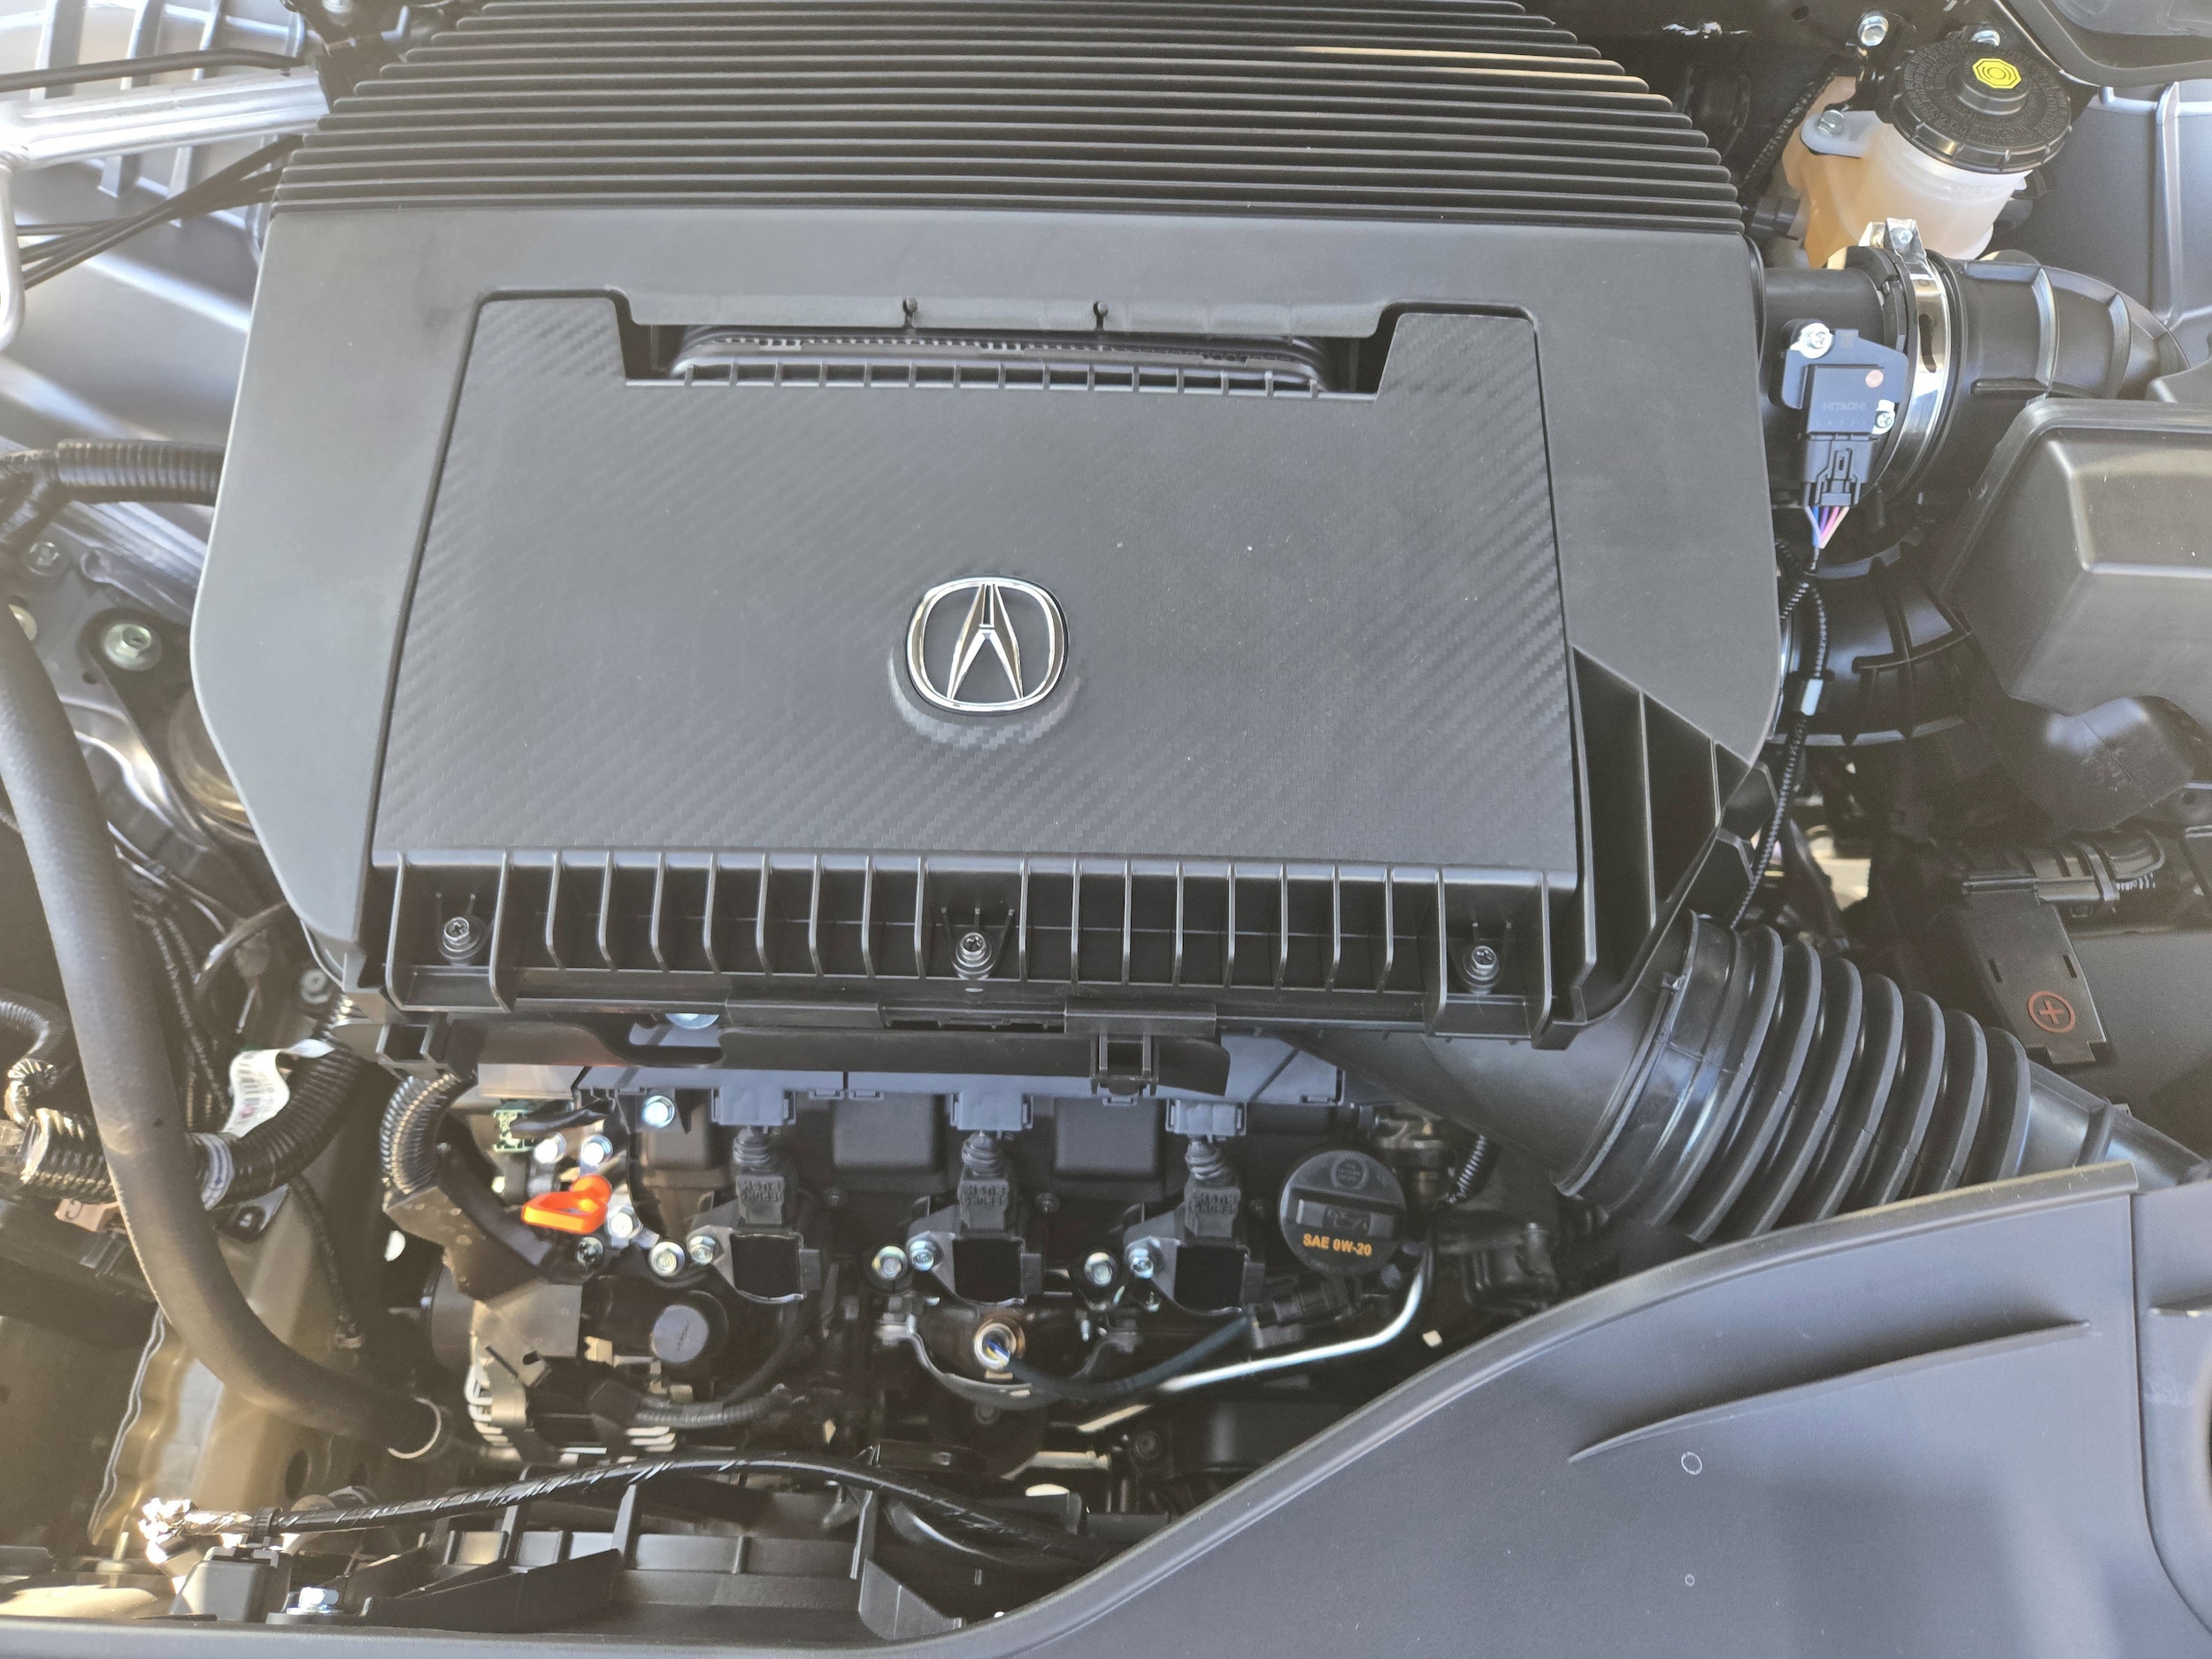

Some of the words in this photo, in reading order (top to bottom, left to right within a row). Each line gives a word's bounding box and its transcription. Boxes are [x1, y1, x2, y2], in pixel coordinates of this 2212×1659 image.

[1822, 401, 1867, 411] HITACHI
[1302, 1233, 1331, 1250] SAE
[1333, 1237, 1372, 1257] 0W-20
